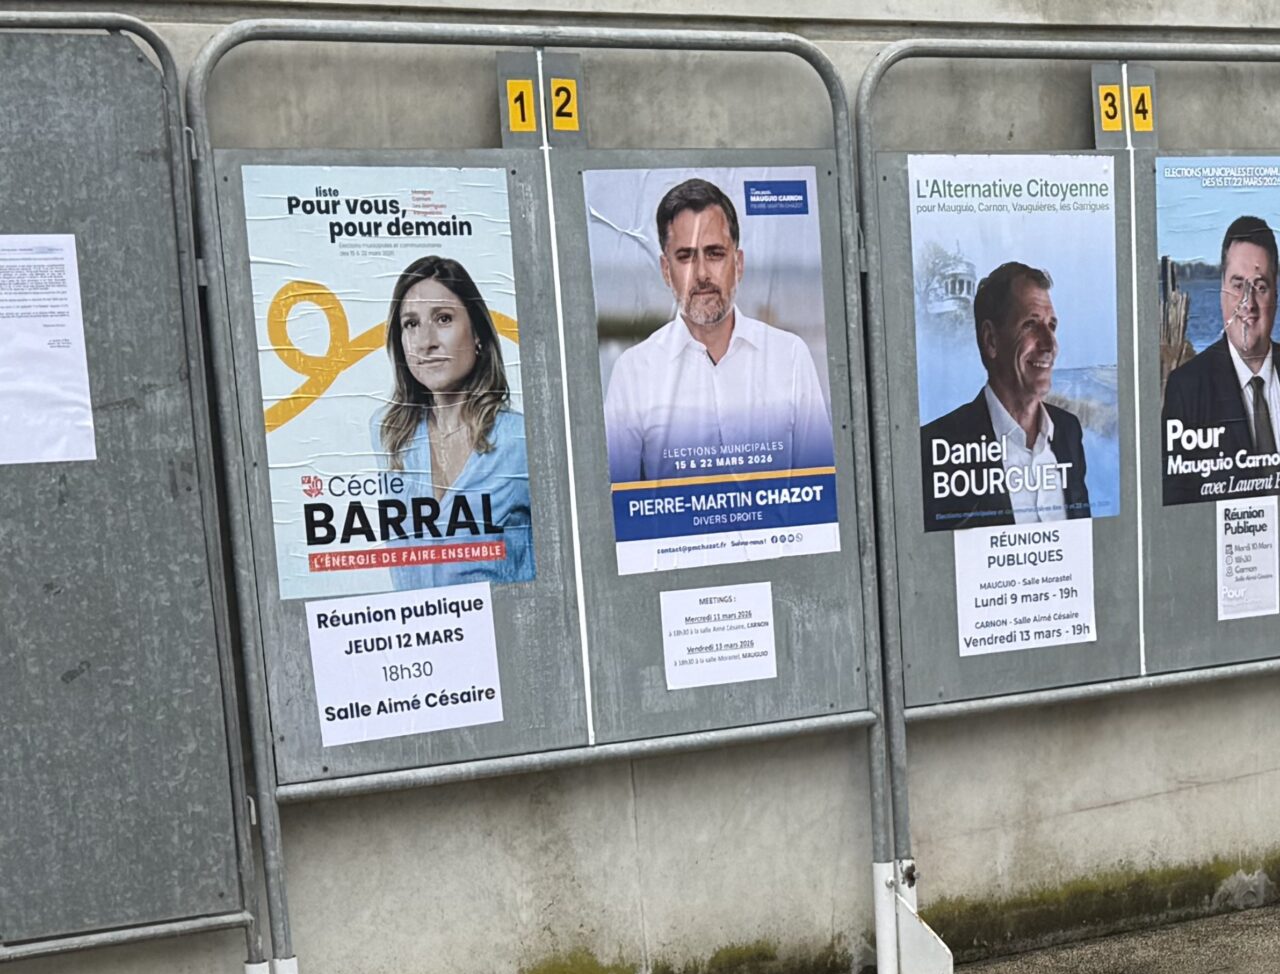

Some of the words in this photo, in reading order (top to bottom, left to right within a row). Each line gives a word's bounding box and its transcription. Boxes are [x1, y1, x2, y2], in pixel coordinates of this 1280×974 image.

[514, 90, 526, 122] 1
[554, 86, 573, 118] 2
[1104, 92, 1118, 120] 3
[1135, 92, 1148, 120] 4
[1202, 166, 1246, 177] MUNICIPALES
[1246, 166, 1254, 176] ET
[1202, 177, 1215, 187] DES
[1231, 177, 1242, 186] 22
[1243, 177, 1263, 186] MARS
[1263, 176, 1280, 186] 2026
[315, 186, 339, 197] liste
[916, 179, 1023, 199] L'Alternative
[1026, 178, 1109, 201] Citoyenne
[287, 196, 341, 215] Pour
[344, 198, 407, 218] vous,
[916, 204, 936, 214] pour
[937, 202, 976, 214] Mauguio,
[978, 202, 1010, 213] Carnon,
[1012, 201, 1058, 214] Vauguières,
[1059, 202, 1071, 211] les
[1072, 201, 1110, 213] Garrigues
[329, 221, 382, 243] pour
[386, 215, 473, 236] demain
[1166, 418, 1226, 451] Pour
[720, 441, 784, 454] MUNICIPALES
[931, 435, 1007, 466] Daniel
[675, 461, 686, 470] 15
[690, 460, 696, 468] &
[700, 459, 712, 468] 22
[716, 456, 744, 466] MARS
[747, 454, 773, 465] 2026
[1167, 451, 1233, 478] Mauguio
[328, 472, 405, 497] Cécile
[933, 462, 1073, 499] BOURGUET
[1200, 482, 1226, 496] avec
[1228, 474, 1273, 493] Laurent
[629, 491, 752, 517] PIERRE-MARTIN
[755, 485, 824, 506] CHAZOT
[304, 493, 504, 546] BARRAL
[693, 514, 727, 526] DIVERS
[729, 511, 763, 523] DROITE
[1224, 506, 1265, 521] Réunion
[990, 530, 1060, 548] RÉUNIONS
[1224, 520, 1268, 536] Publique
[313, 552, 377, 569] L'ÉNERGIE
[382, 552, 398, 564] DE
[402, 549, 436, 562] FAIRE
[441, 545, 501, 559] ENSEMBLE
[988, 549, 1063, 568] PUBLIQUES
[1022, 578, 1040, 586] Salle
[699, 596, 733, 605] MEETINGS
[974, 594, 1007, 608] Lundi
[1010, 593, 1018, 604] 9
[1021, 592, 1050, 604] mars
[1059, 587, 1078, 599] 19h
[316, 606, 396, 629] Réunion
[400, 597, 484, 625] publique
[975, 619, 1008, 629] CARNON
[1013, 617, 1031, 625] Salle
[1033, 614, 1052, 623] Aimé
[1053, 611, 1079, 621] Césaire
[344, 635, 393, 655] JEUDI
[396, 633, 413, 649] 12
[416, 627, 464, 647] MARS
[963, 631, 1017, 648] Vendredi
[1019, 630, 1031, 642] 13
[1034, 628, 1062, 640] mars
[1071, 624, 1090, 635] 19h
[382, 660, 434, 683] 18h30
[324, 701, 372, 722] Salle
[376, 693, 421, 716] Aimé
[425, 686, 496, 708] Césaire
